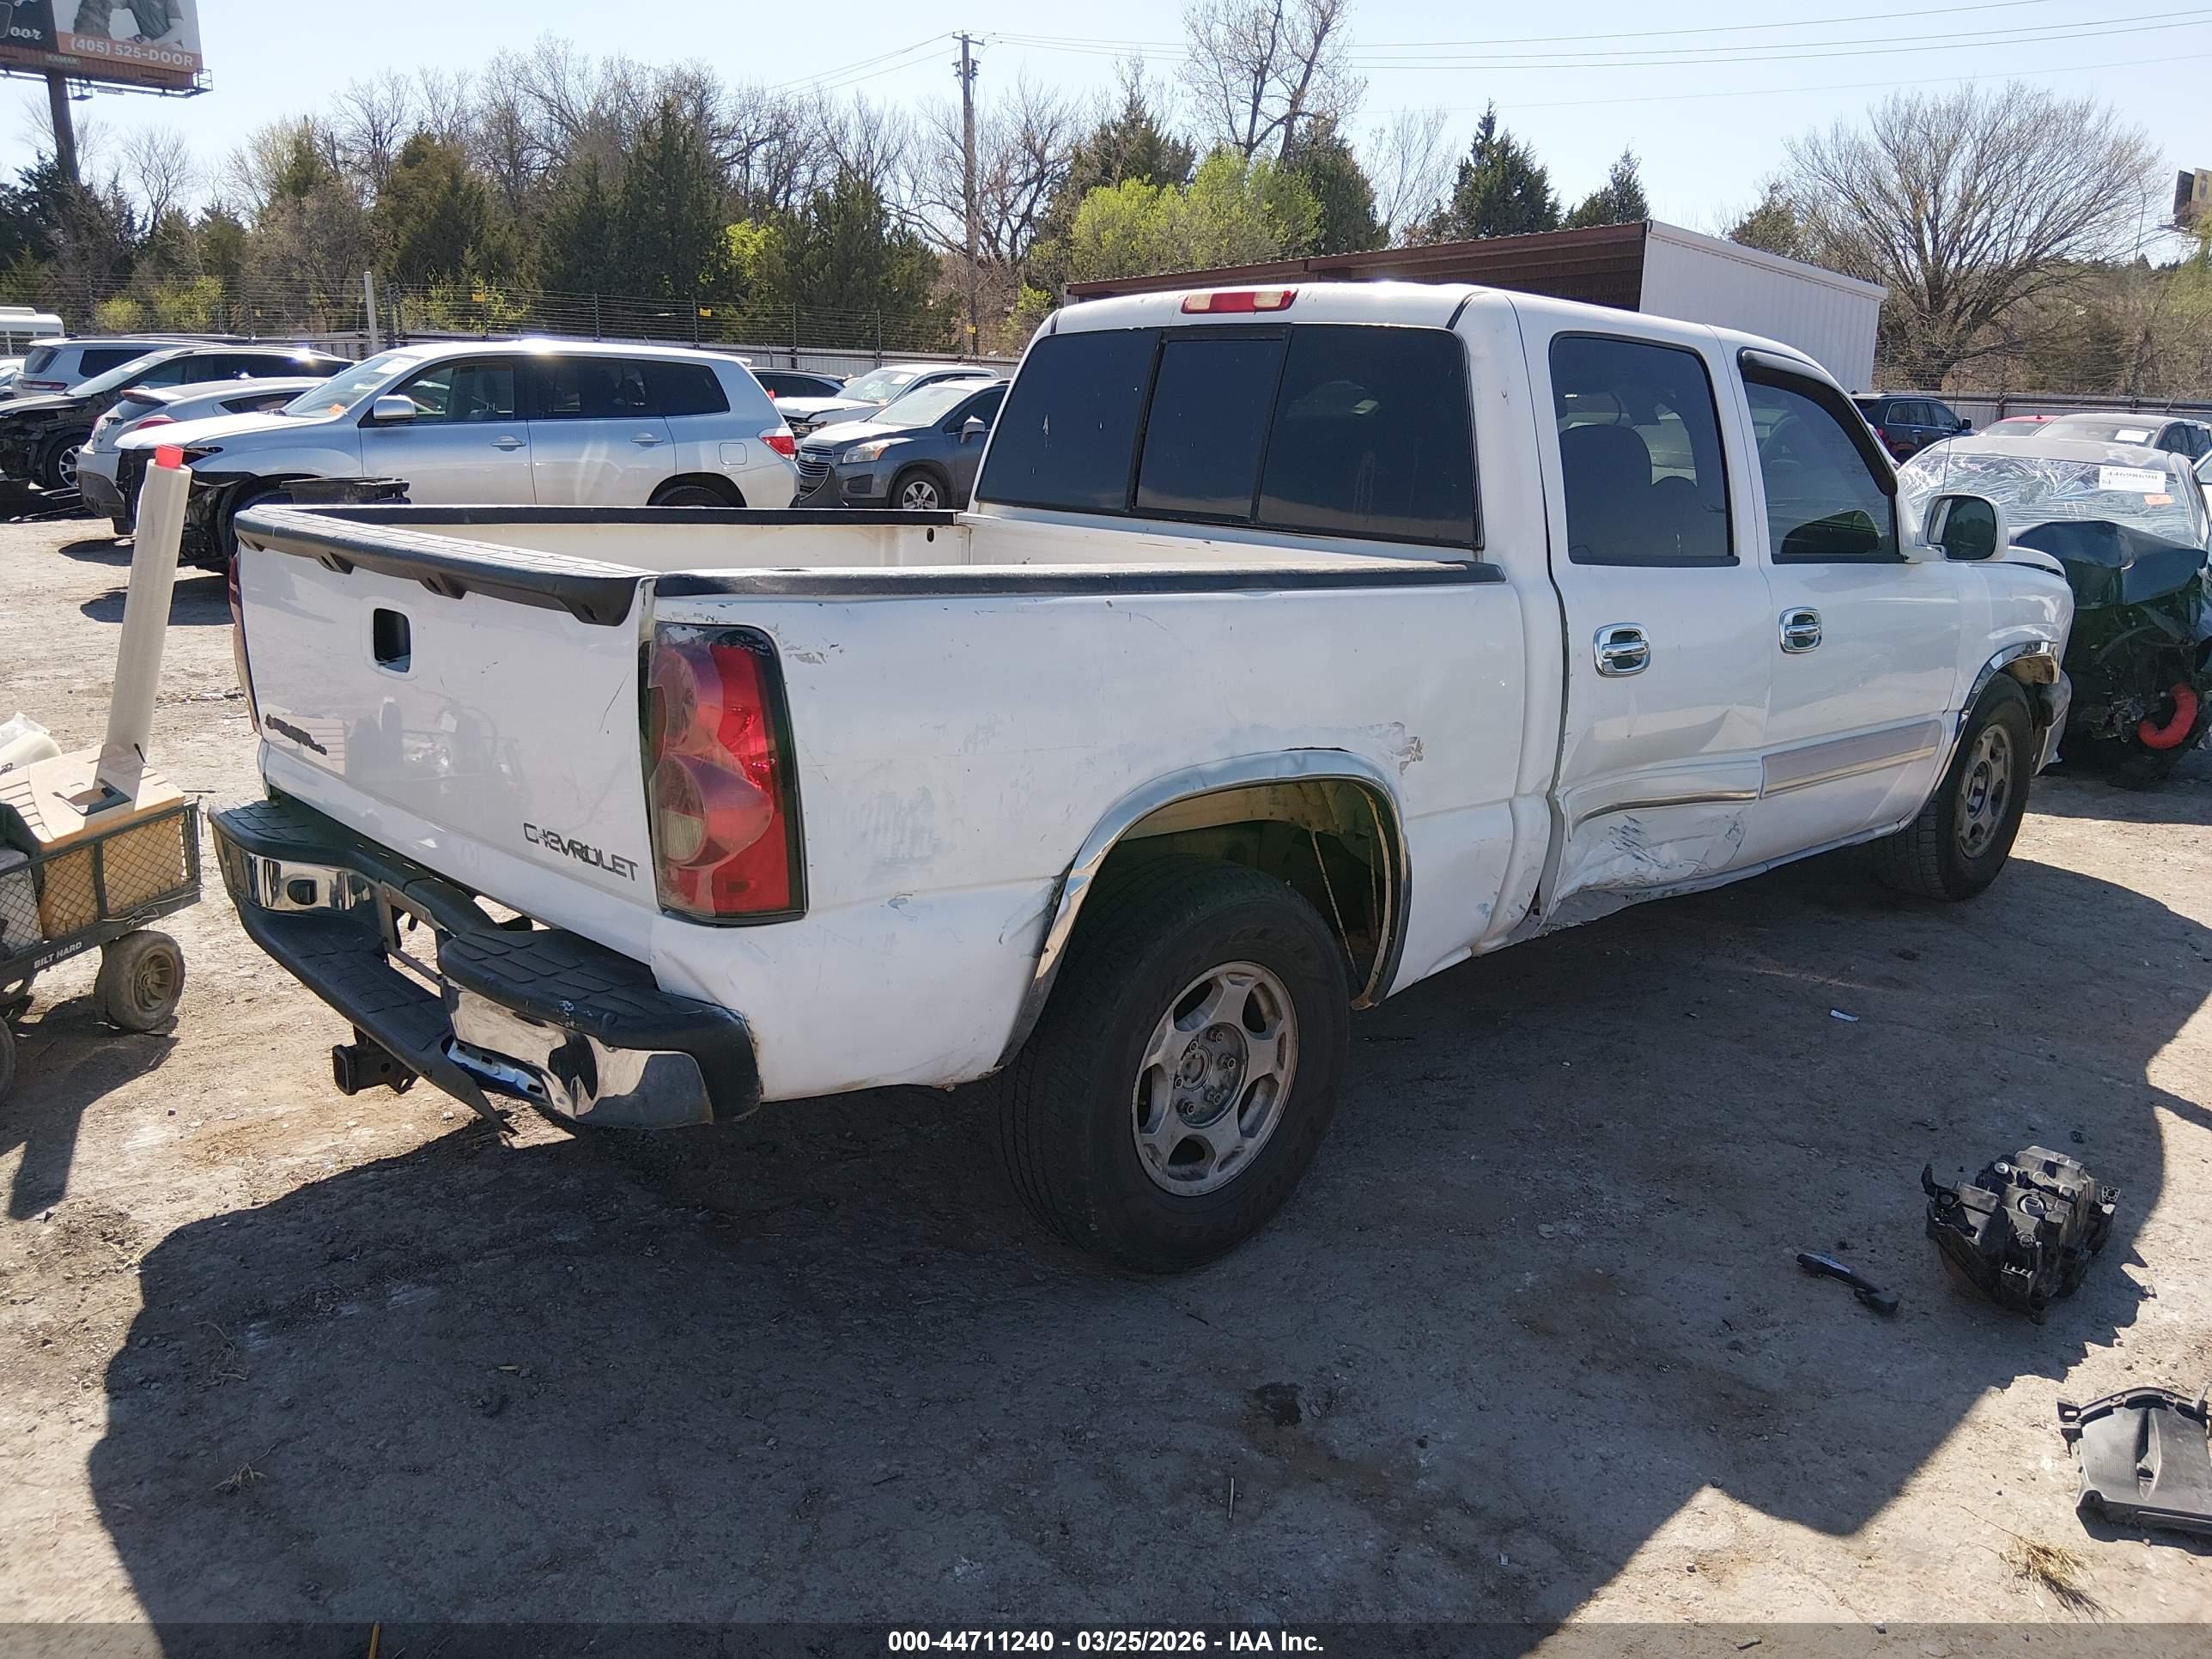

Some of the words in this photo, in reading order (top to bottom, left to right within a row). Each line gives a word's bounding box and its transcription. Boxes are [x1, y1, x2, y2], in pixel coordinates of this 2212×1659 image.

[70, 37, 111, 56] (405)
[115, 44, 193, 67] 525-DOOR
[523, 822, 639, 882] CHEVROLET
[33, 953, 55, 969] BILT
[56, 941, 82, 959] HARD
